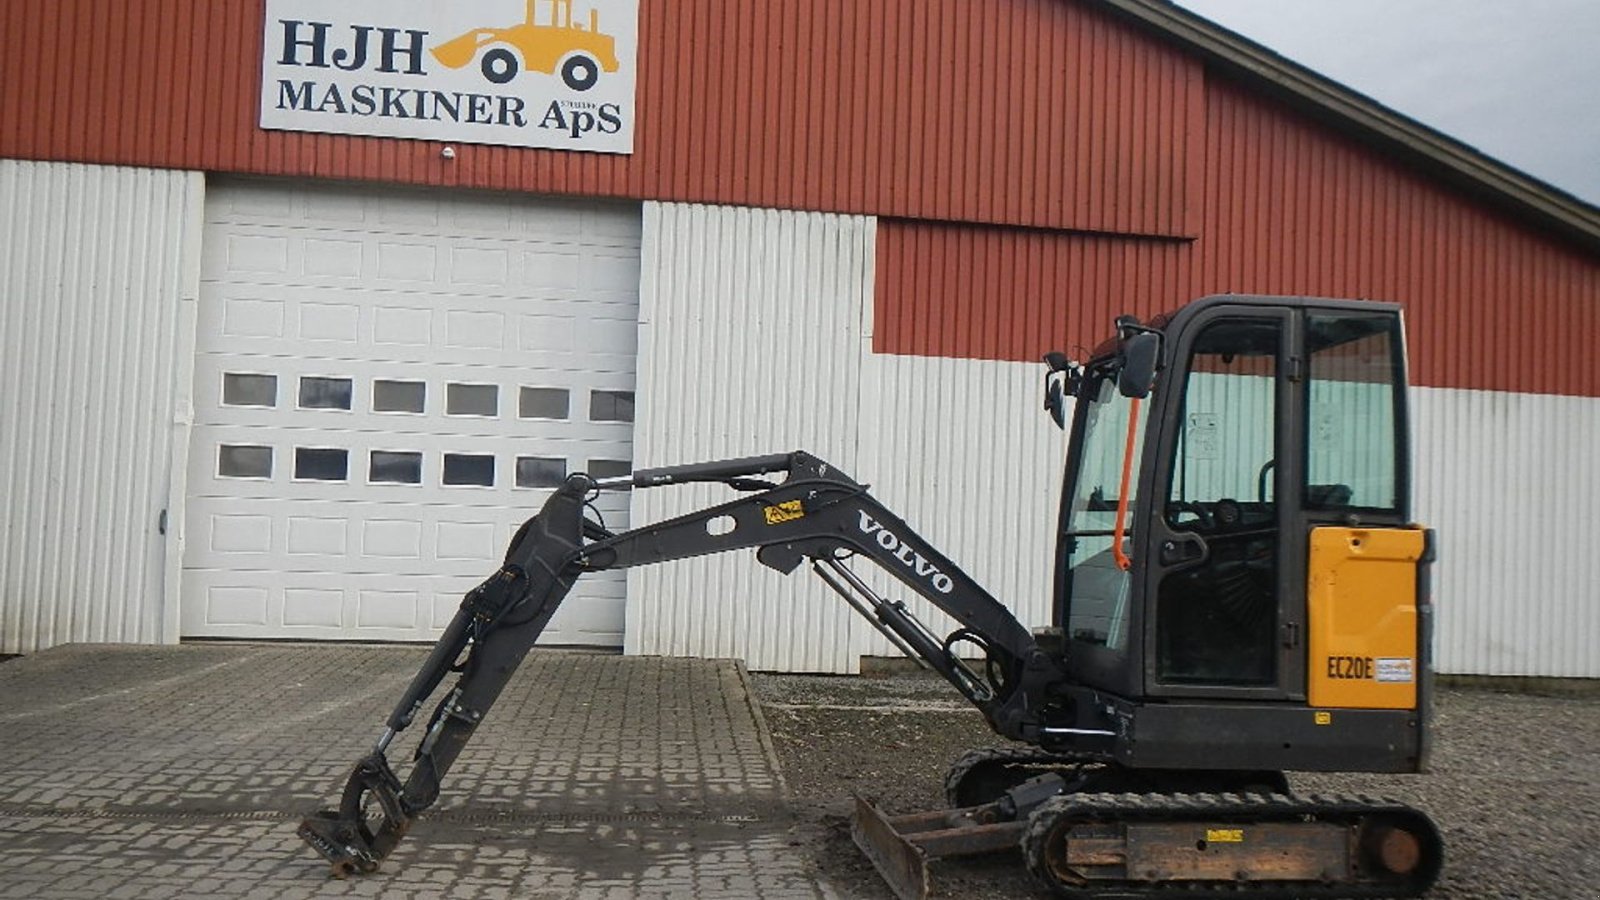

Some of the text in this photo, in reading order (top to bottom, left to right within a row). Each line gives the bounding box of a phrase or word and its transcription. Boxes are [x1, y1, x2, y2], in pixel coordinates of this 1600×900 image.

[277, 19, 429, 76] HJH
[275, 79, 622, 138] MASKINER ApS
[858, 509, 954, 594] VOLVO
[1327, 656, 1373, 679] EC20E
